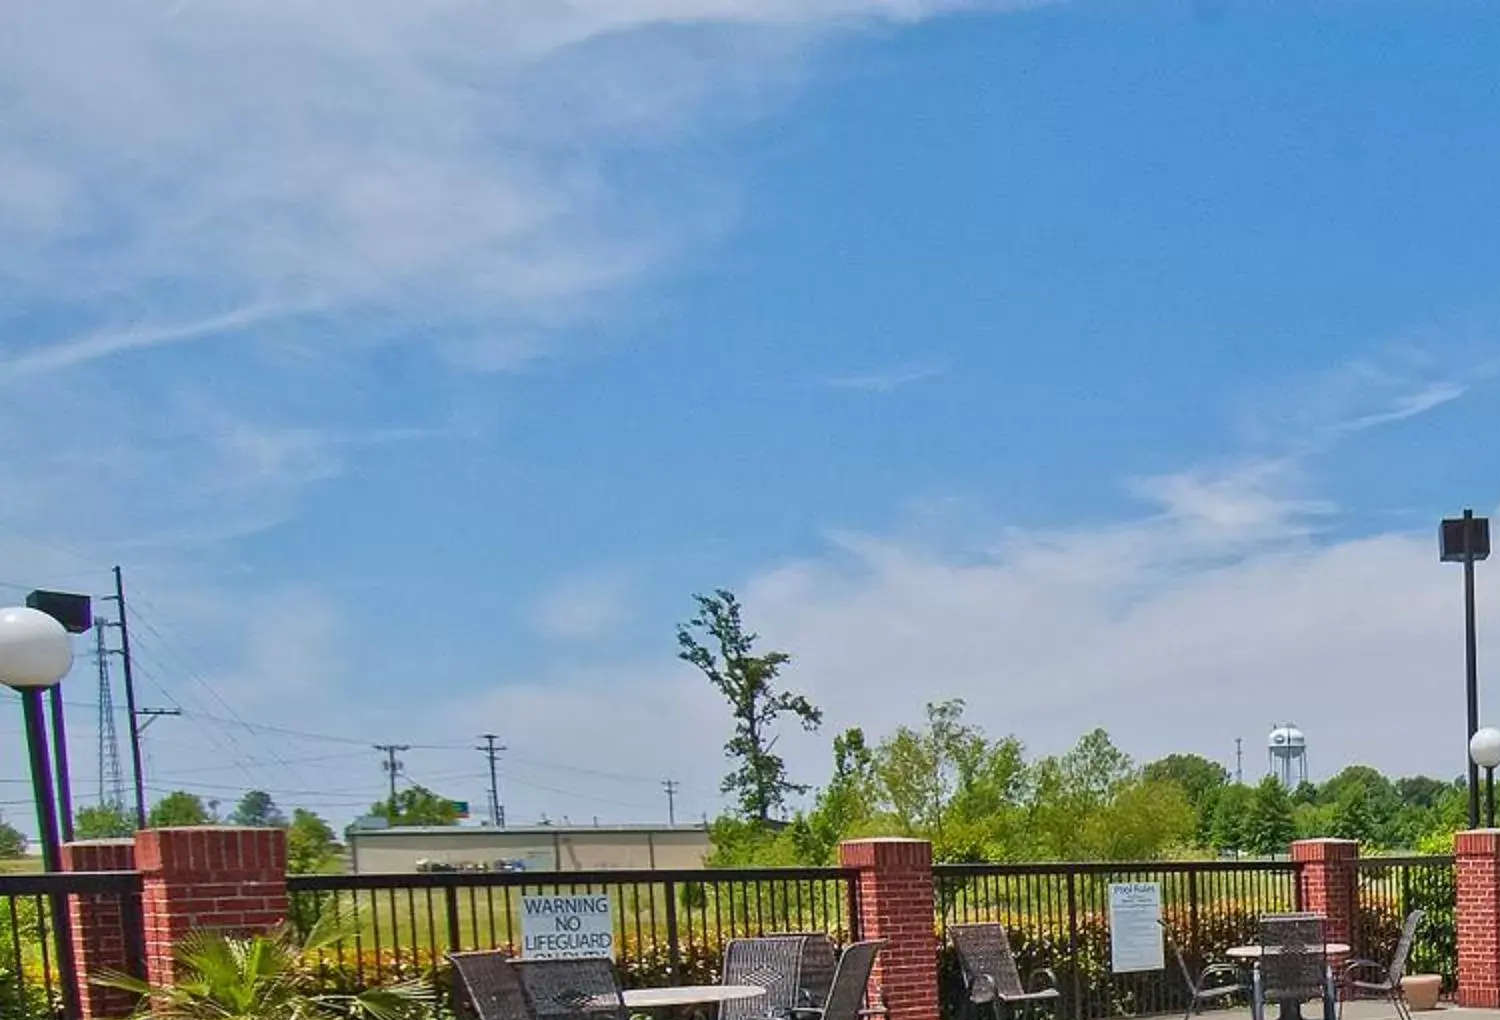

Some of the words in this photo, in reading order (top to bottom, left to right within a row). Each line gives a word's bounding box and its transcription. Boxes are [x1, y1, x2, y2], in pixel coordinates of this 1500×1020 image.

[523, 897, 609, 914] WARNING
[555, 915, 581, 932] NO
[525, 931, 612, 951] LIFEGUARD
